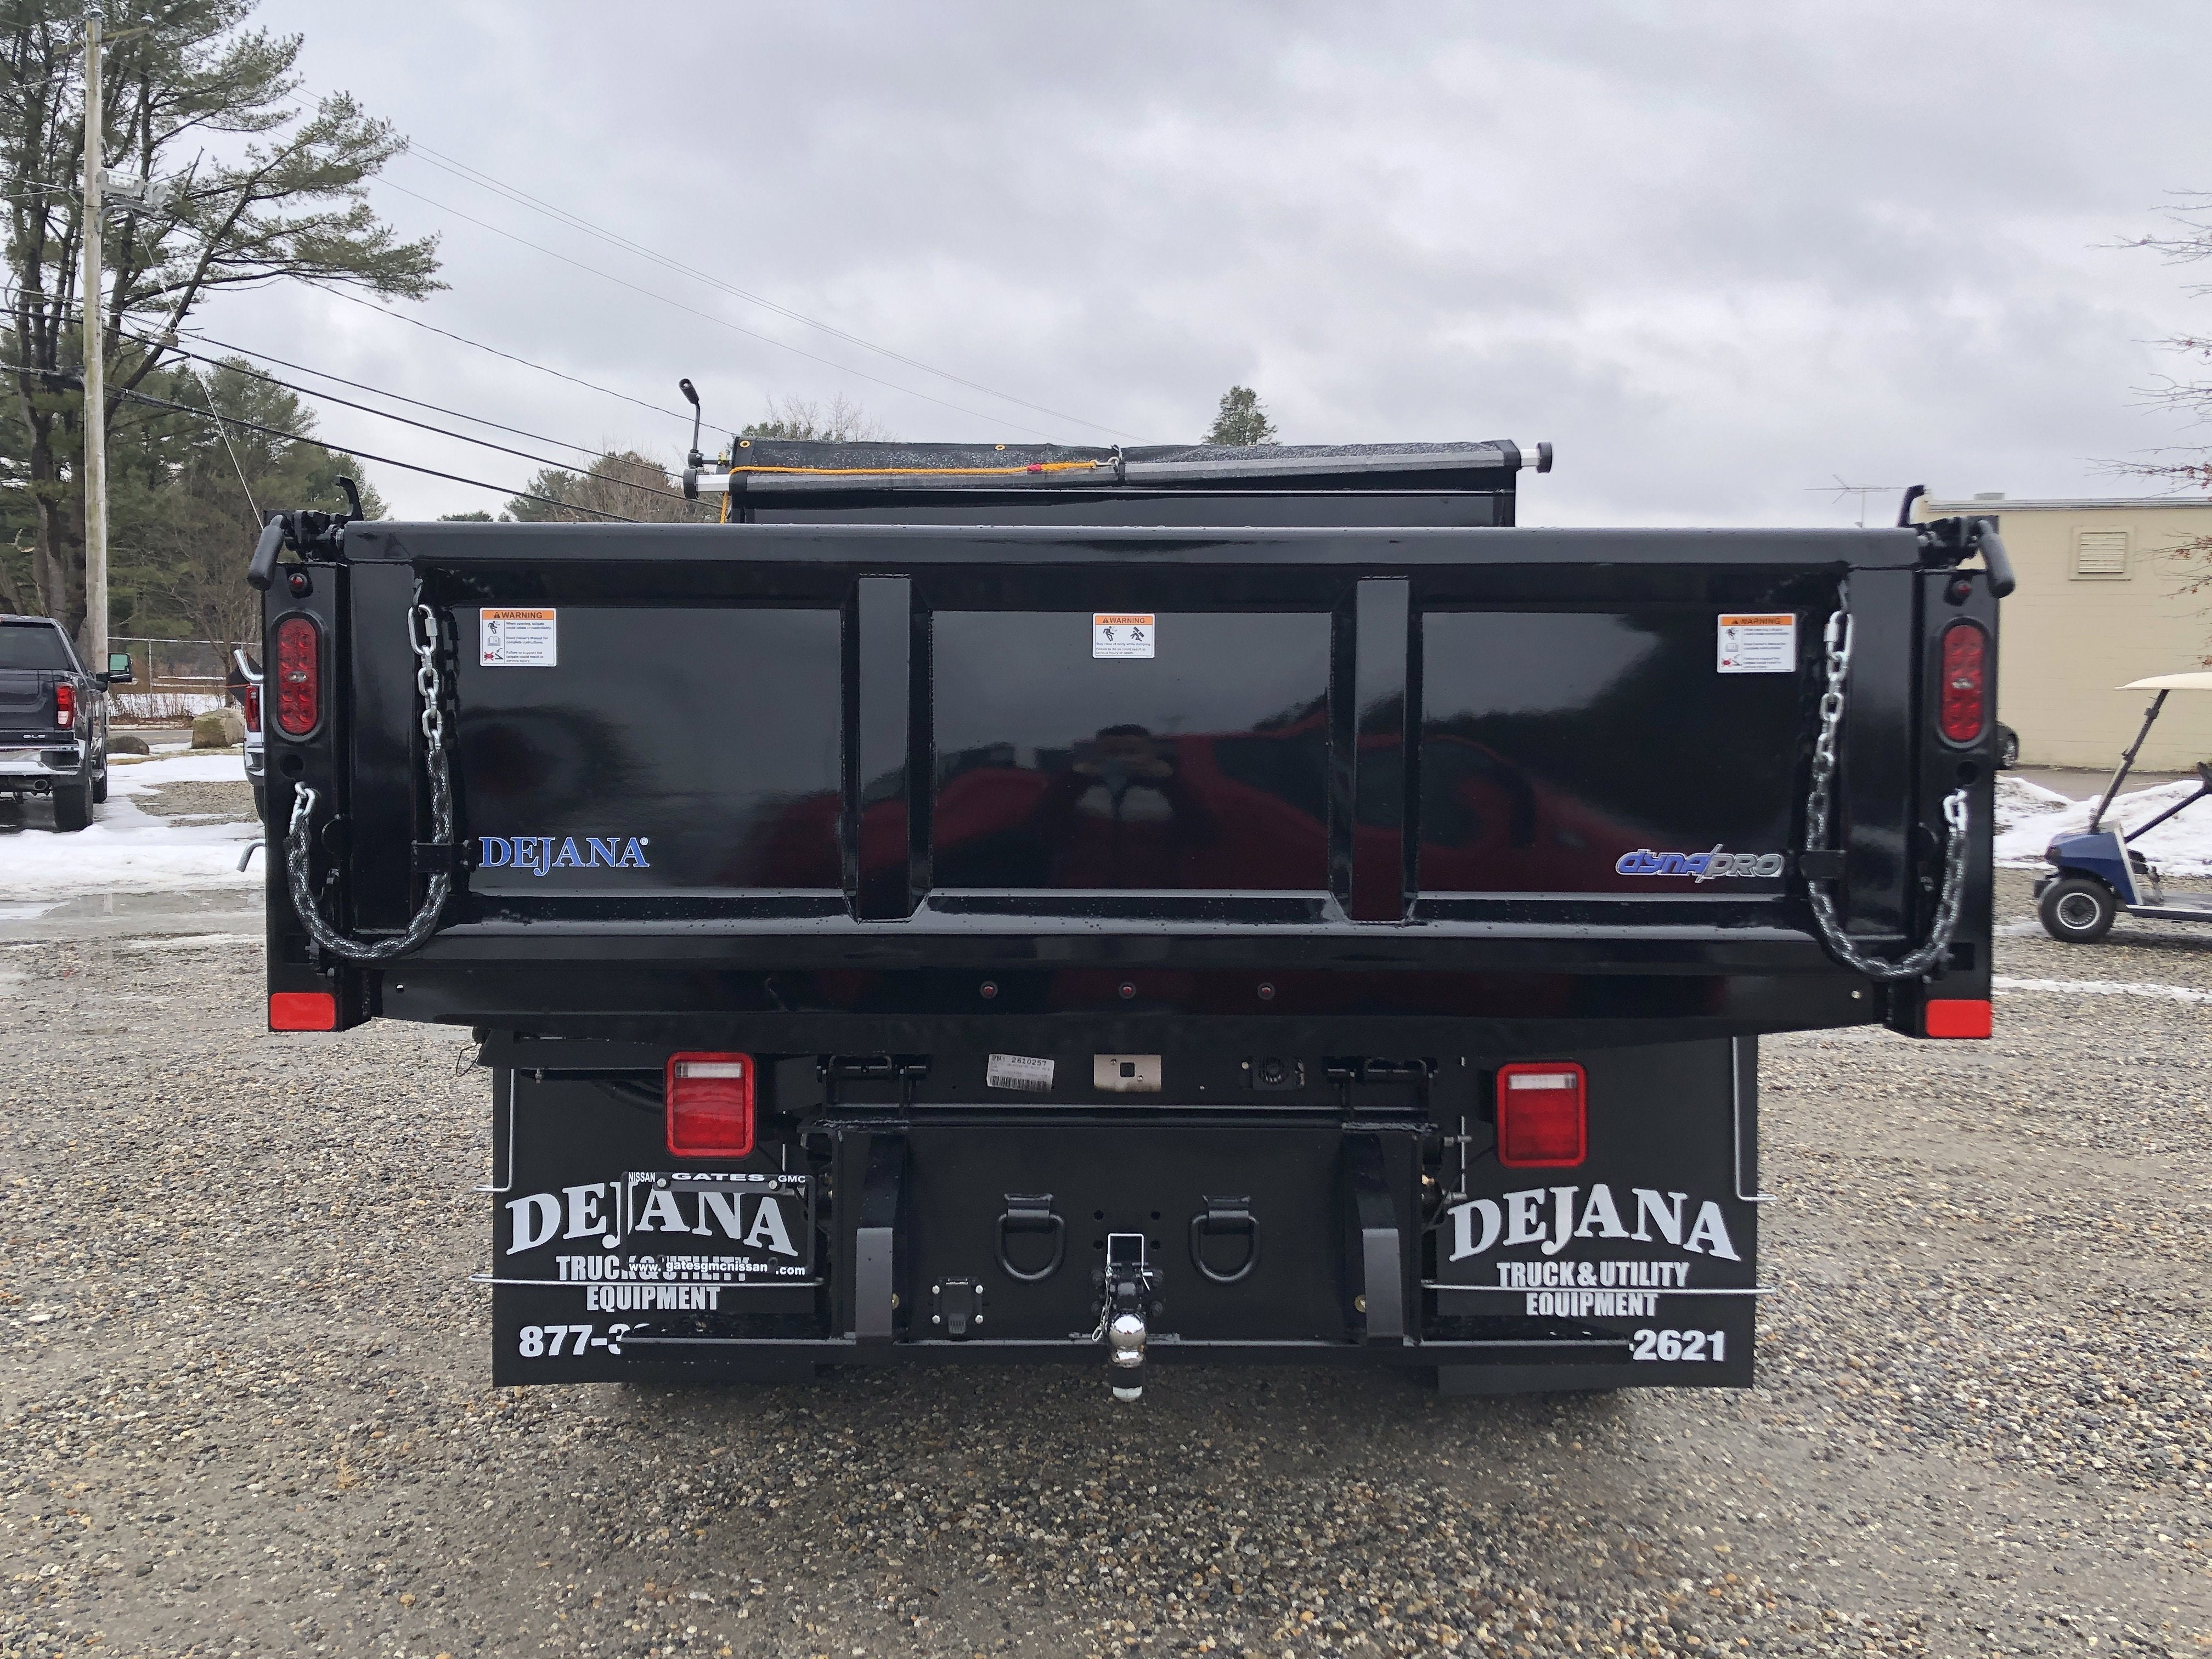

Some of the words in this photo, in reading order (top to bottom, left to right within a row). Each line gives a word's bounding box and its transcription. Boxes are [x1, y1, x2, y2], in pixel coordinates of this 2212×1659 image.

[1011, 1057, 1046, 1066] 2610257
[628, 1172, 656, 1183] NISSAN
[672, 1172, 765, 1181] GATES
[778, 1175, 806, 1183] GMC
[505, 1181, 798, 1257] DEJANA
[1447, 1183, 1741, 1262] DEJANA
[665, 1260, 768, 1273] gatesgmcnissan
[587, 1286, 720, 1312] EQUIPMENT
[1526, 1291, 1659, 1317] EQUIPMENT
[519, 1323, 650, 1357] 877-3
